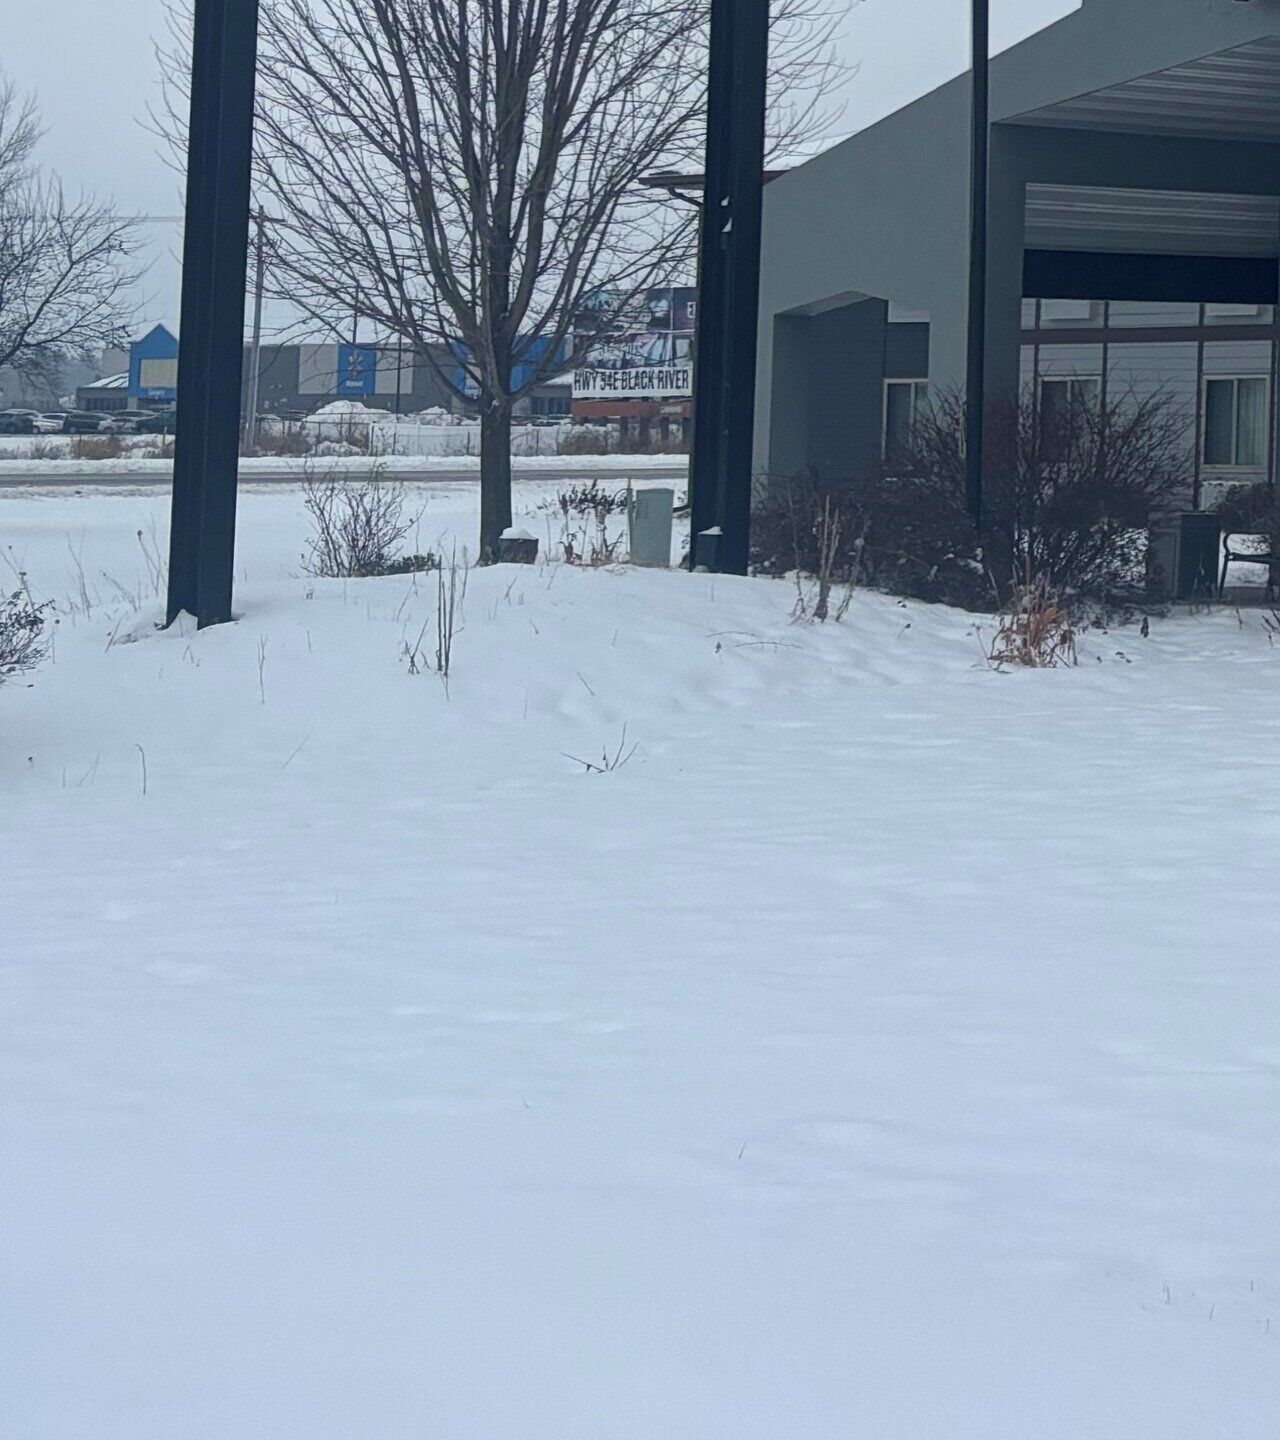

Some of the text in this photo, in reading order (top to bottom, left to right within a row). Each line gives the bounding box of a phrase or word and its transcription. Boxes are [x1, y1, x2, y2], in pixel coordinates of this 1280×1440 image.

[574, 370, 598, 391] HWY
[621, 370, 655, 390] BLACK
[657, 369, 689, 390] RIVER
